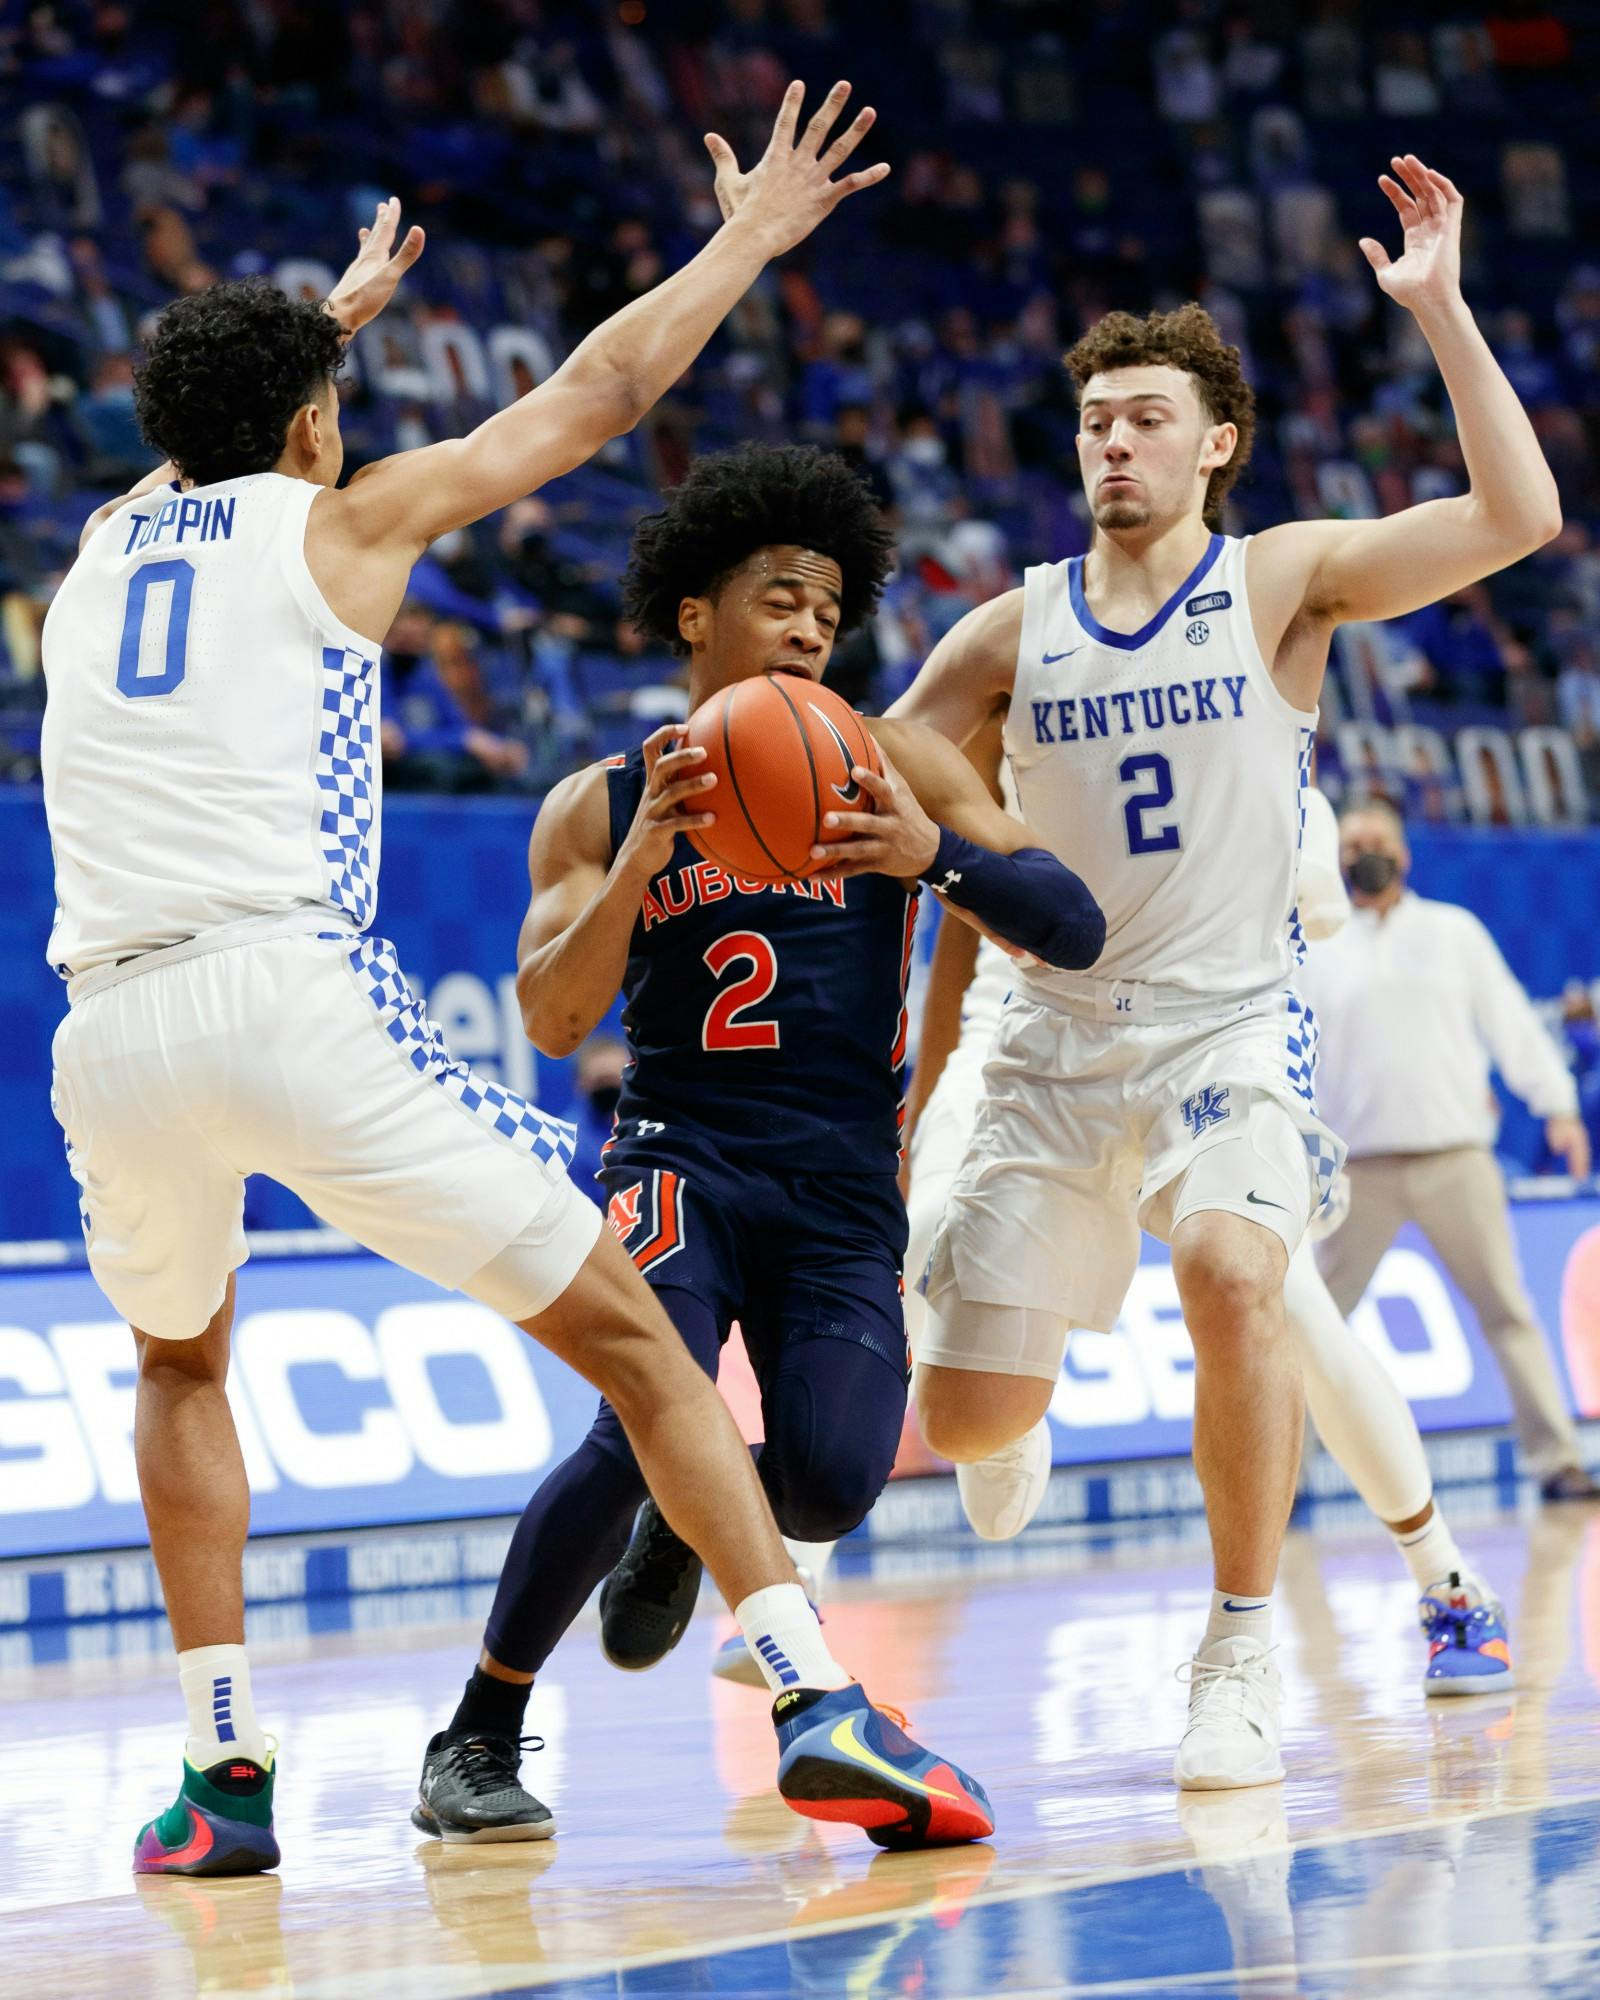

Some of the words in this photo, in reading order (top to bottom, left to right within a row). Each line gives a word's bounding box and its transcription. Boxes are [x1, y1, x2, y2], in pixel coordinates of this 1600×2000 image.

[124, 497, 236, 555] TOPPIN
[114, 556, 197, 700] 0
[1187, 621, 1209, 645] SEC
[1031, 675, 1247, 744] KENTUCKY
[1117, 751, 1183, 857] 2
[702, 930, 780, 1051] 2
